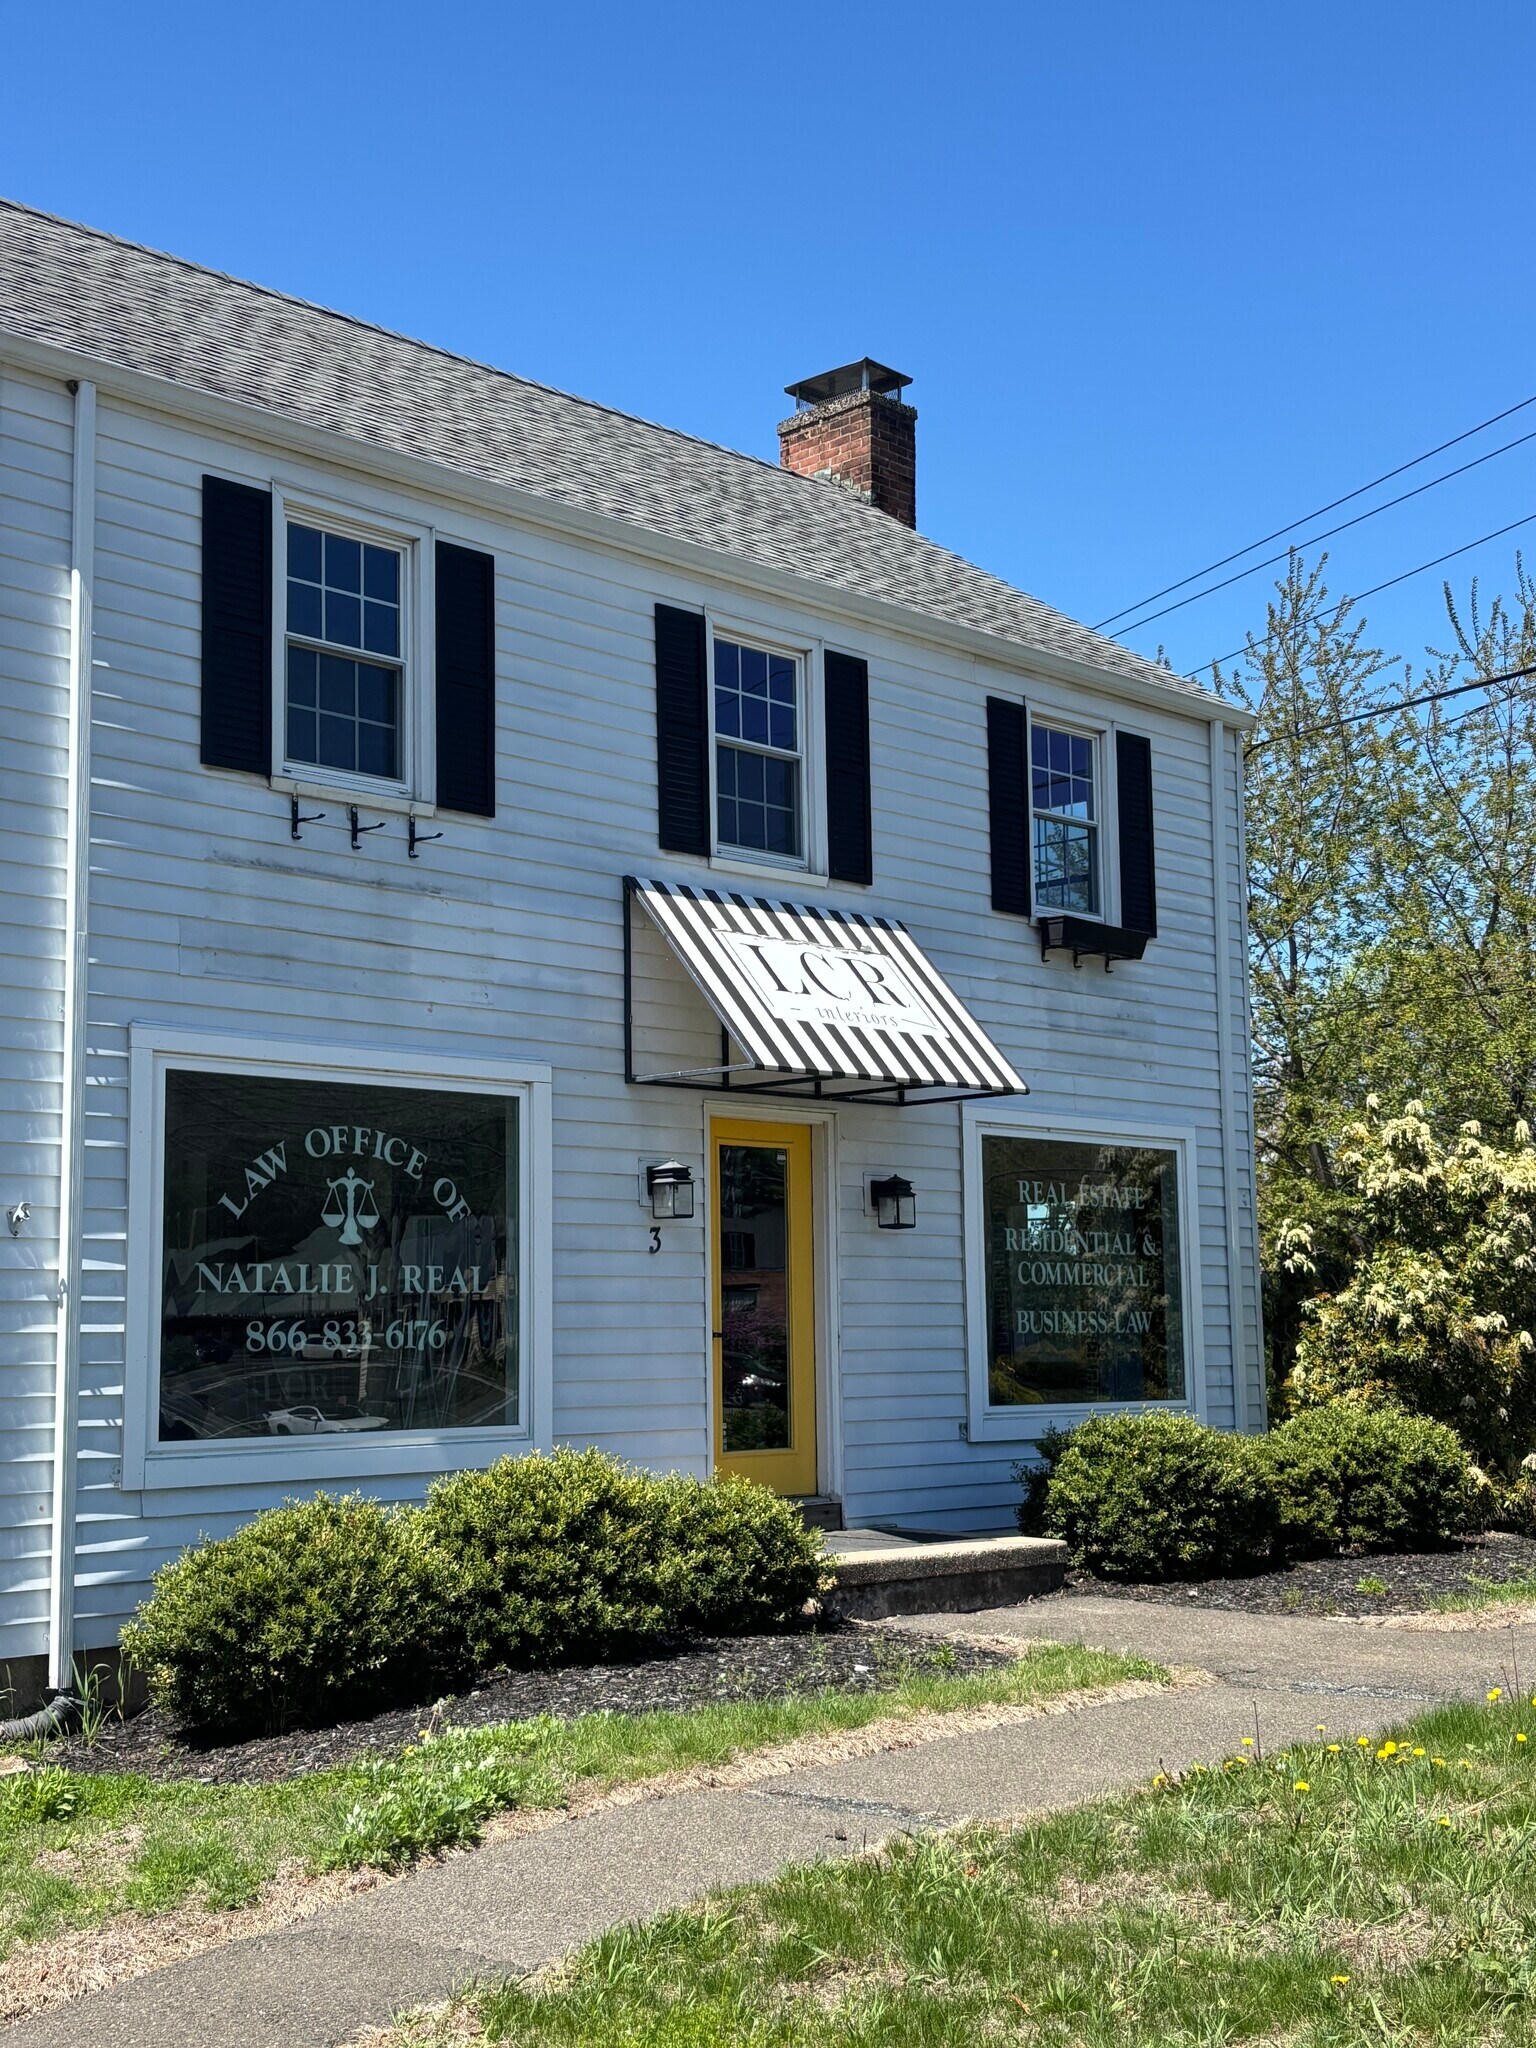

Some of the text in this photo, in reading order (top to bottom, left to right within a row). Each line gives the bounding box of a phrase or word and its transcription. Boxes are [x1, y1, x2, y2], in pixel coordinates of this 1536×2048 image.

[739, 943, 911, 1008] LCR
[814, 1005, 899, 1027] interiors
[217, 1125, 472, 1223] LAW OFFICE OF
[1018, 1180, 1146, 1210] REAL ESTATE
[648, 1226, 662, 1254] 3
[1004, 1227, 1160, 1257] RESIDENTIAL &
[195, 1263, 488, 1301] NATALIE J. REAL
[1017, 1261, 1150, 1288] COMMERCIAL
[246, 1319, 447, 1352] 866-833-6176
[1016, 1310, 1153, 1334] BUSINESS LAW
[264, 1373, 330, 1401] LCR
